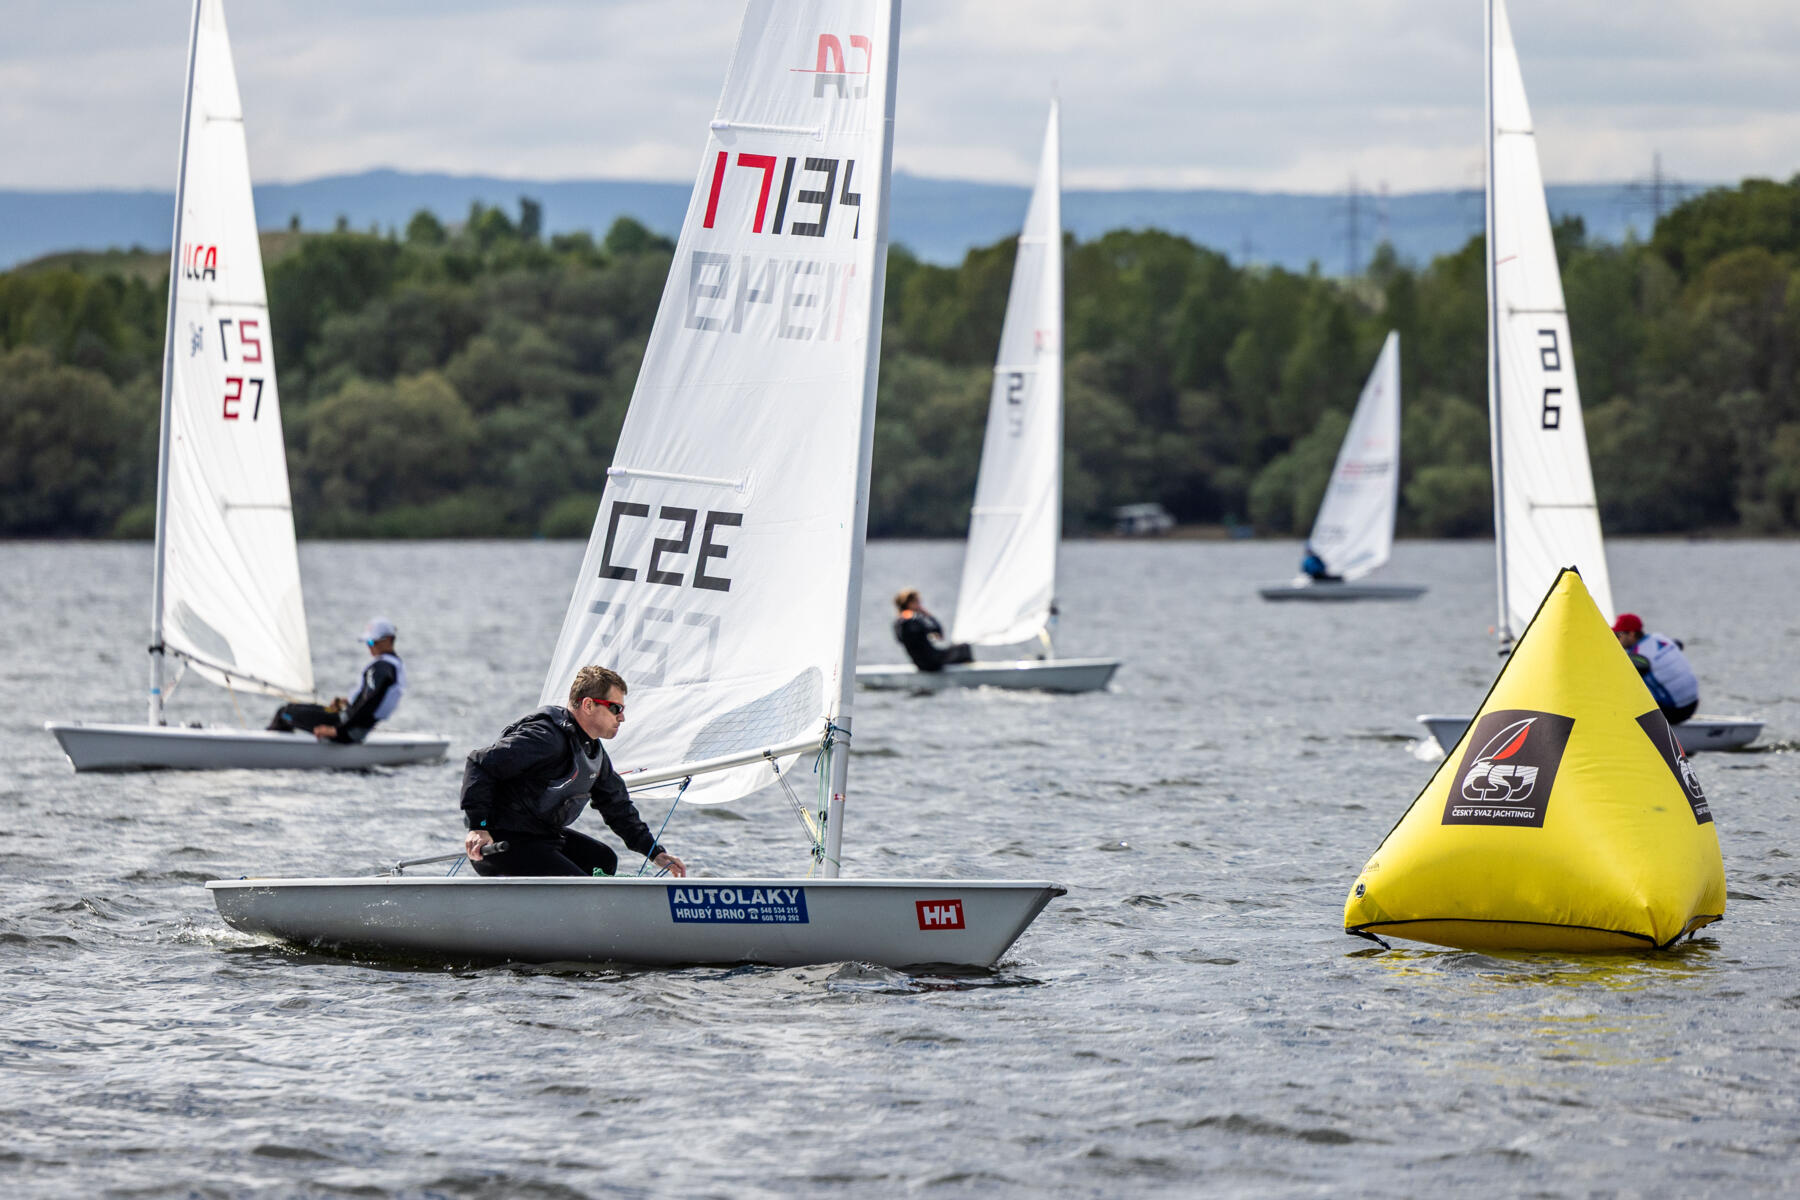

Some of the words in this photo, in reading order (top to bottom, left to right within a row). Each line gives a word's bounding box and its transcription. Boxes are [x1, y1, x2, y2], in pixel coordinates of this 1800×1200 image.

[182, 243, 217, 282] ILCA
[223, 377, 264, 421] 27
[1542, 388, 1562, 430] 6
[598, 501, 743, 592] CZE
[1452, 808, 1473, 817] ČESKÝ
[1474, 809, 1493, 817] SVAZ
[1492, 810, 1535, 819] JACHTINGU
[673, 889, 799, 905] AUTOLAKY
[676, 906, 712, 919] HRUBÝ
[715, 908, 745, 920] BRNO
[922, 905, 958, 925] HH
